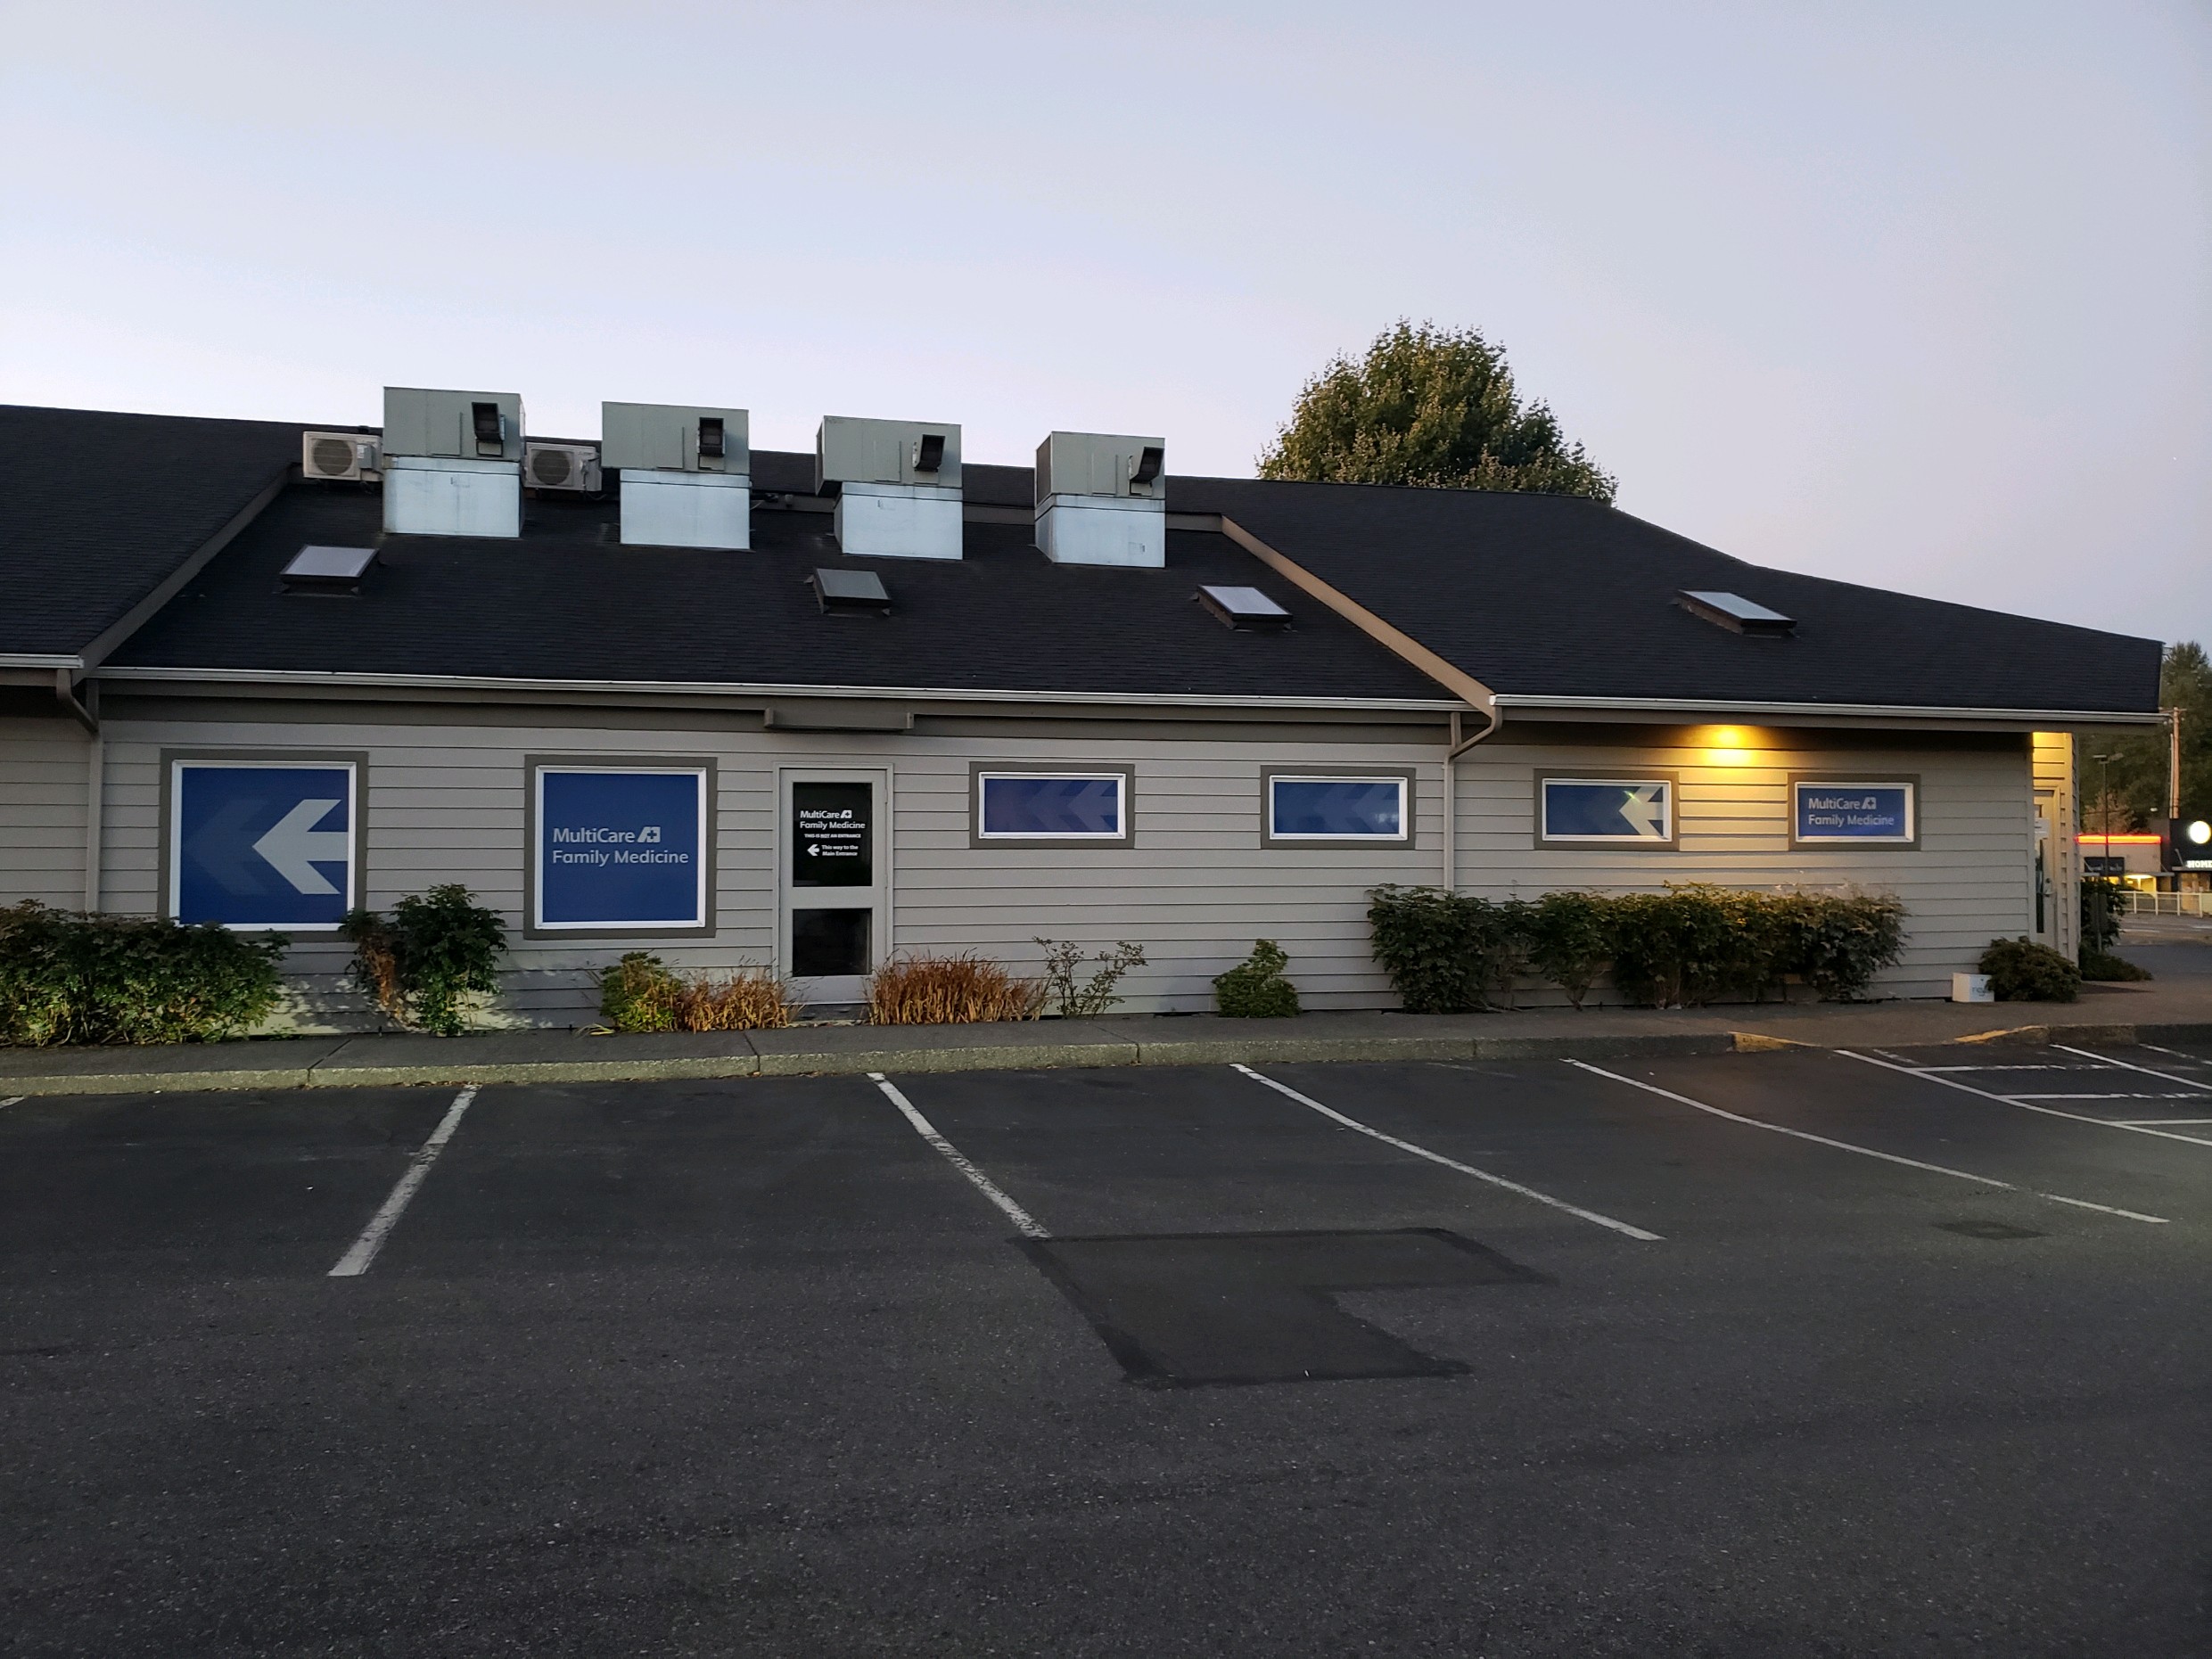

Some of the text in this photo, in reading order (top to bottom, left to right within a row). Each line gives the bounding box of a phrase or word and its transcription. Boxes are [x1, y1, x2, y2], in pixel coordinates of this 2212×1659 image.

[1808, 797, 1861, 810] MultiCare
[800, 809, 840, 819] MultiCare
[800, 821, 866, 830] Family Medicine
[1808, 814, 1895, 828] Family Medicine
[553, 827, 635, 843] MultiCare
[552, 850, 688, 866] Family Medicine
